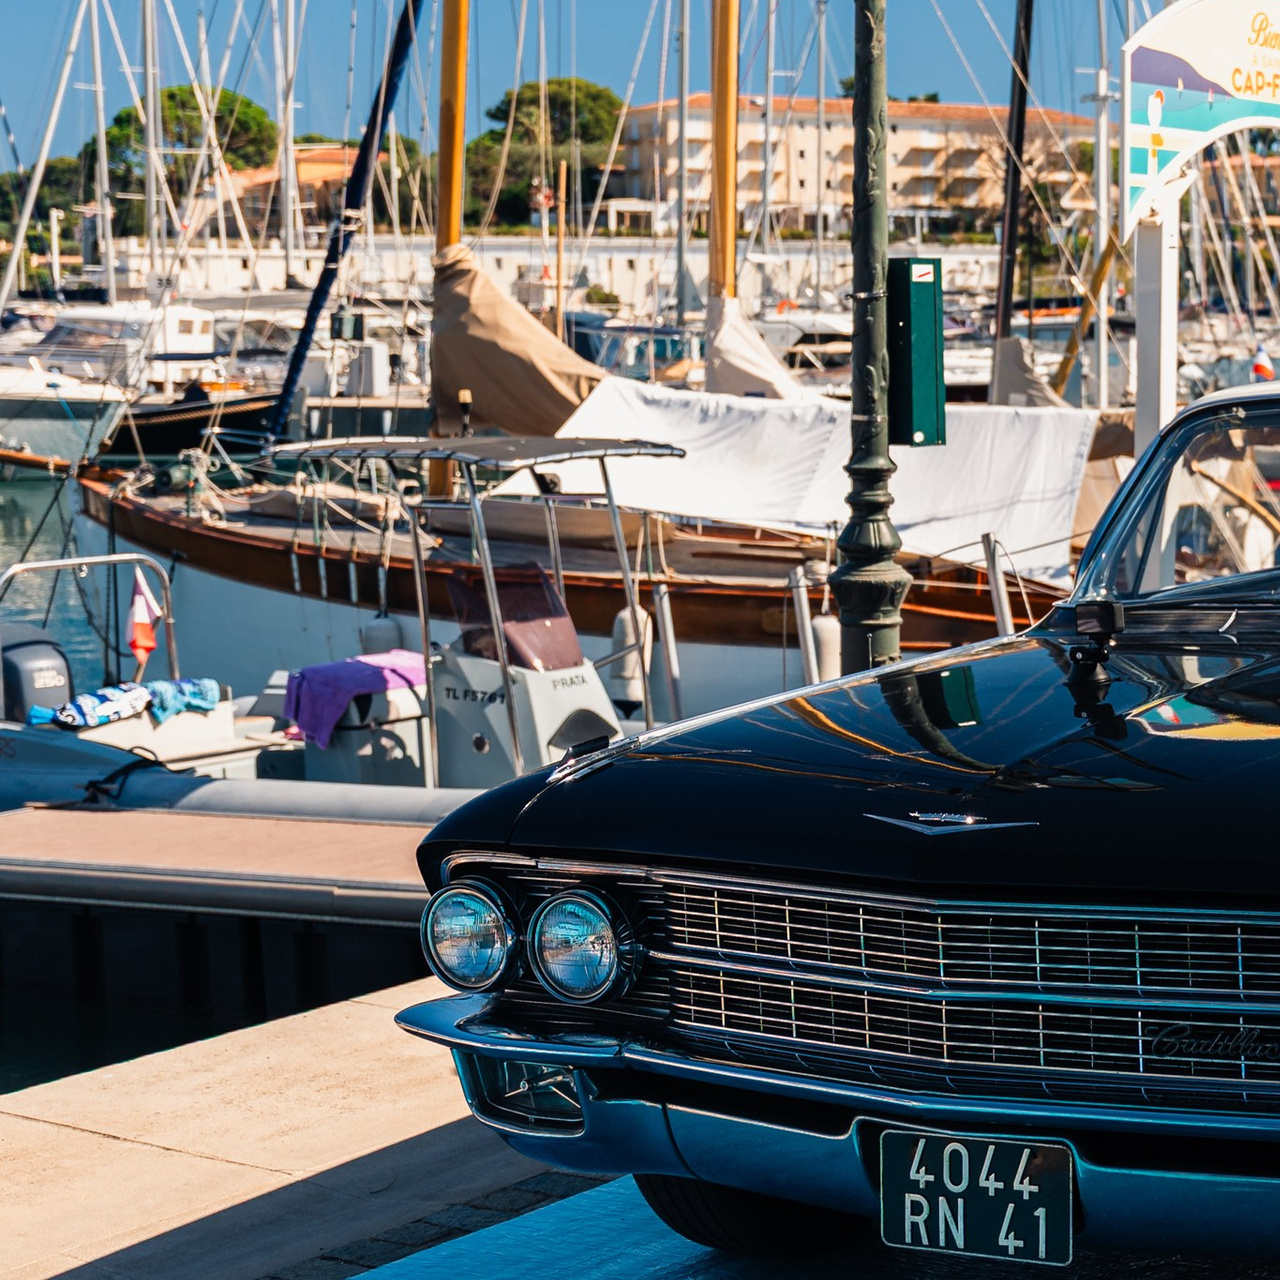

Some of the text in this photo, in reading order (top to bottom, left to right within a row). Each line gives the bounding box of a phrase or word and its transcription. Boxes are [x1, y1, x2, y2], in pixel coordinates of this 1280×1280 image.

[909, 1138, 1040, 1201] 4044
[904, 1192, 1047, 1260] RN 41
